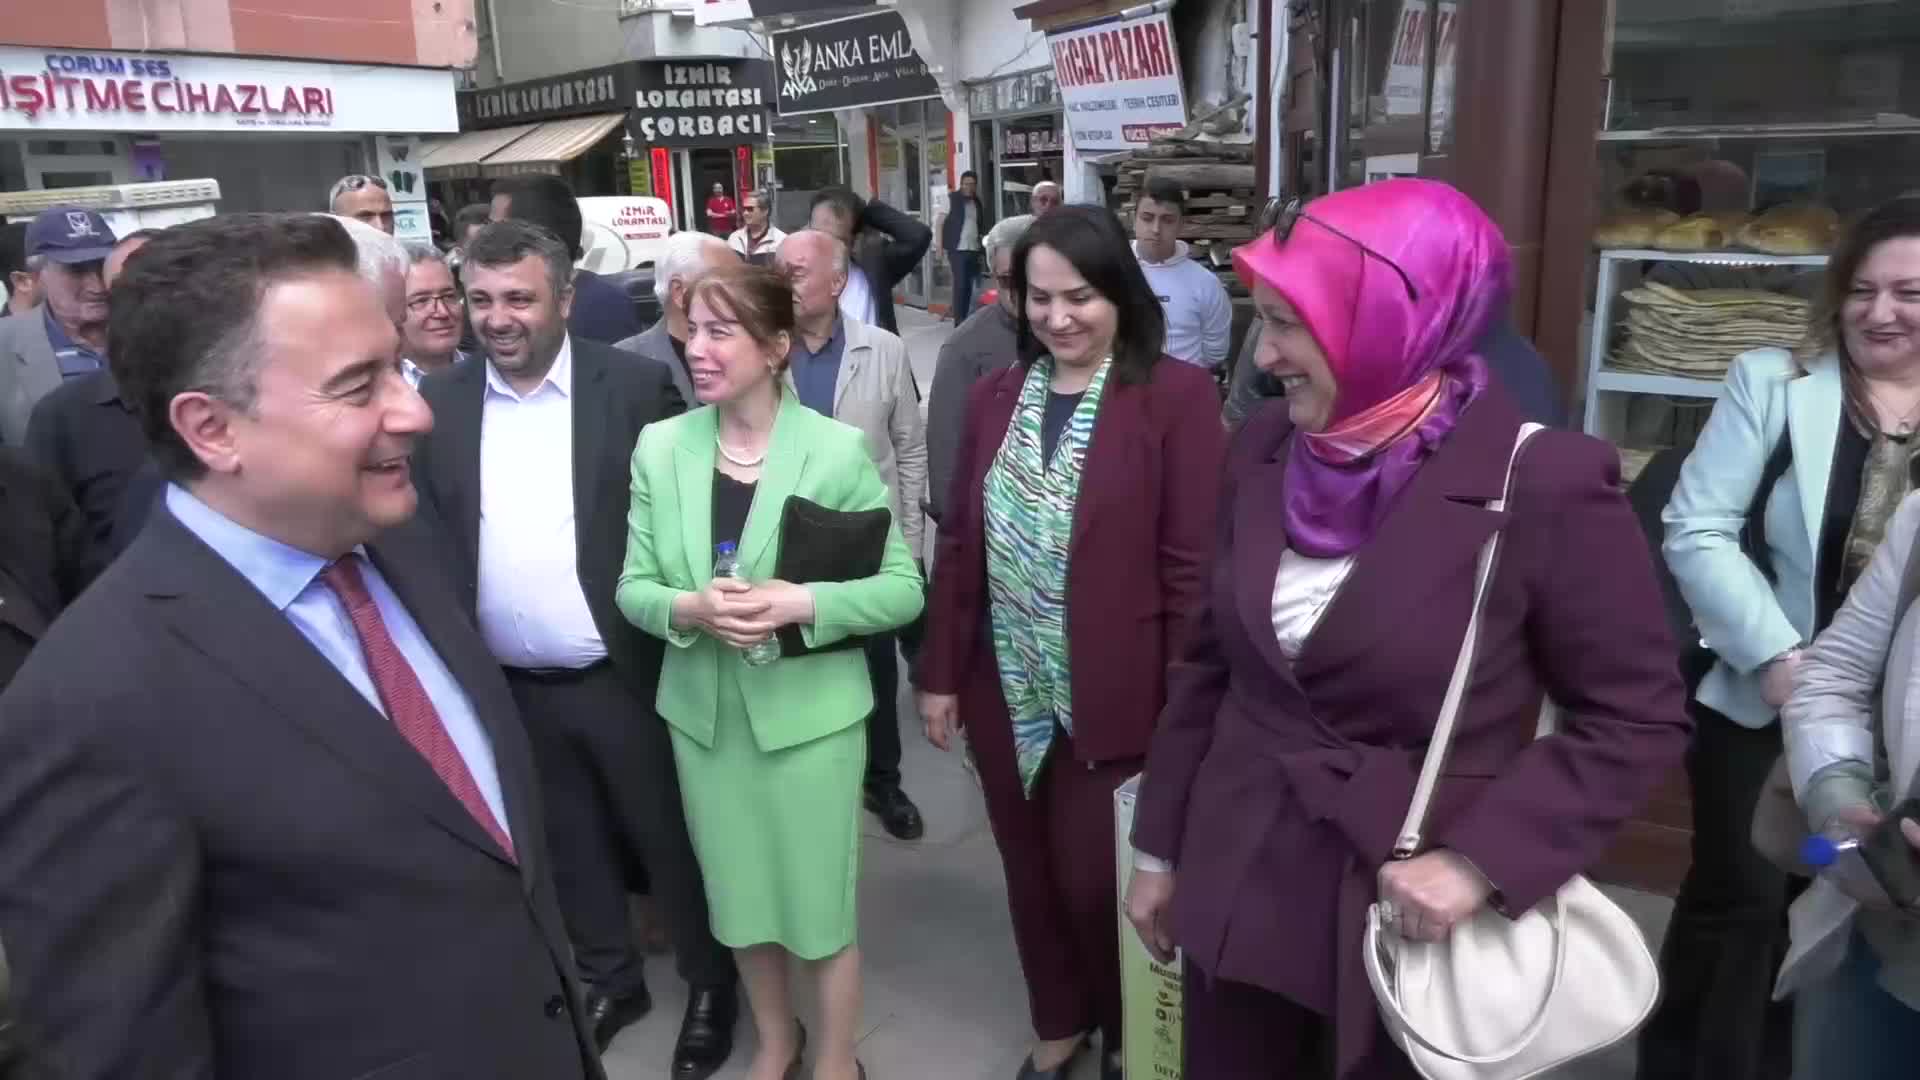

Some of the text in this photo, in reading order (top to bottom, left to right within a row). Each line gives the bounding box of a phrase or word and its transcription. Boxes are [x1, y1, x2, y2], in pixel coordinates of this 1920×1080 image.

[814, 37, 865, 72] ANKA
[1100, 20, 1174, 82] PAZARI
[130, 59, 171, 77] SES
[664, 63, 732, 85] İZMİR
[0, 70, 334, 118] İŞİTME CİHAZLARI
[521, 75, 617, 113] LOKANTASI
[635, 87, 762, 109] LOKANTASI
[640, 113, 762, 141] ÇORBACI
[612, 216, 667, 227] LOKANTASI
